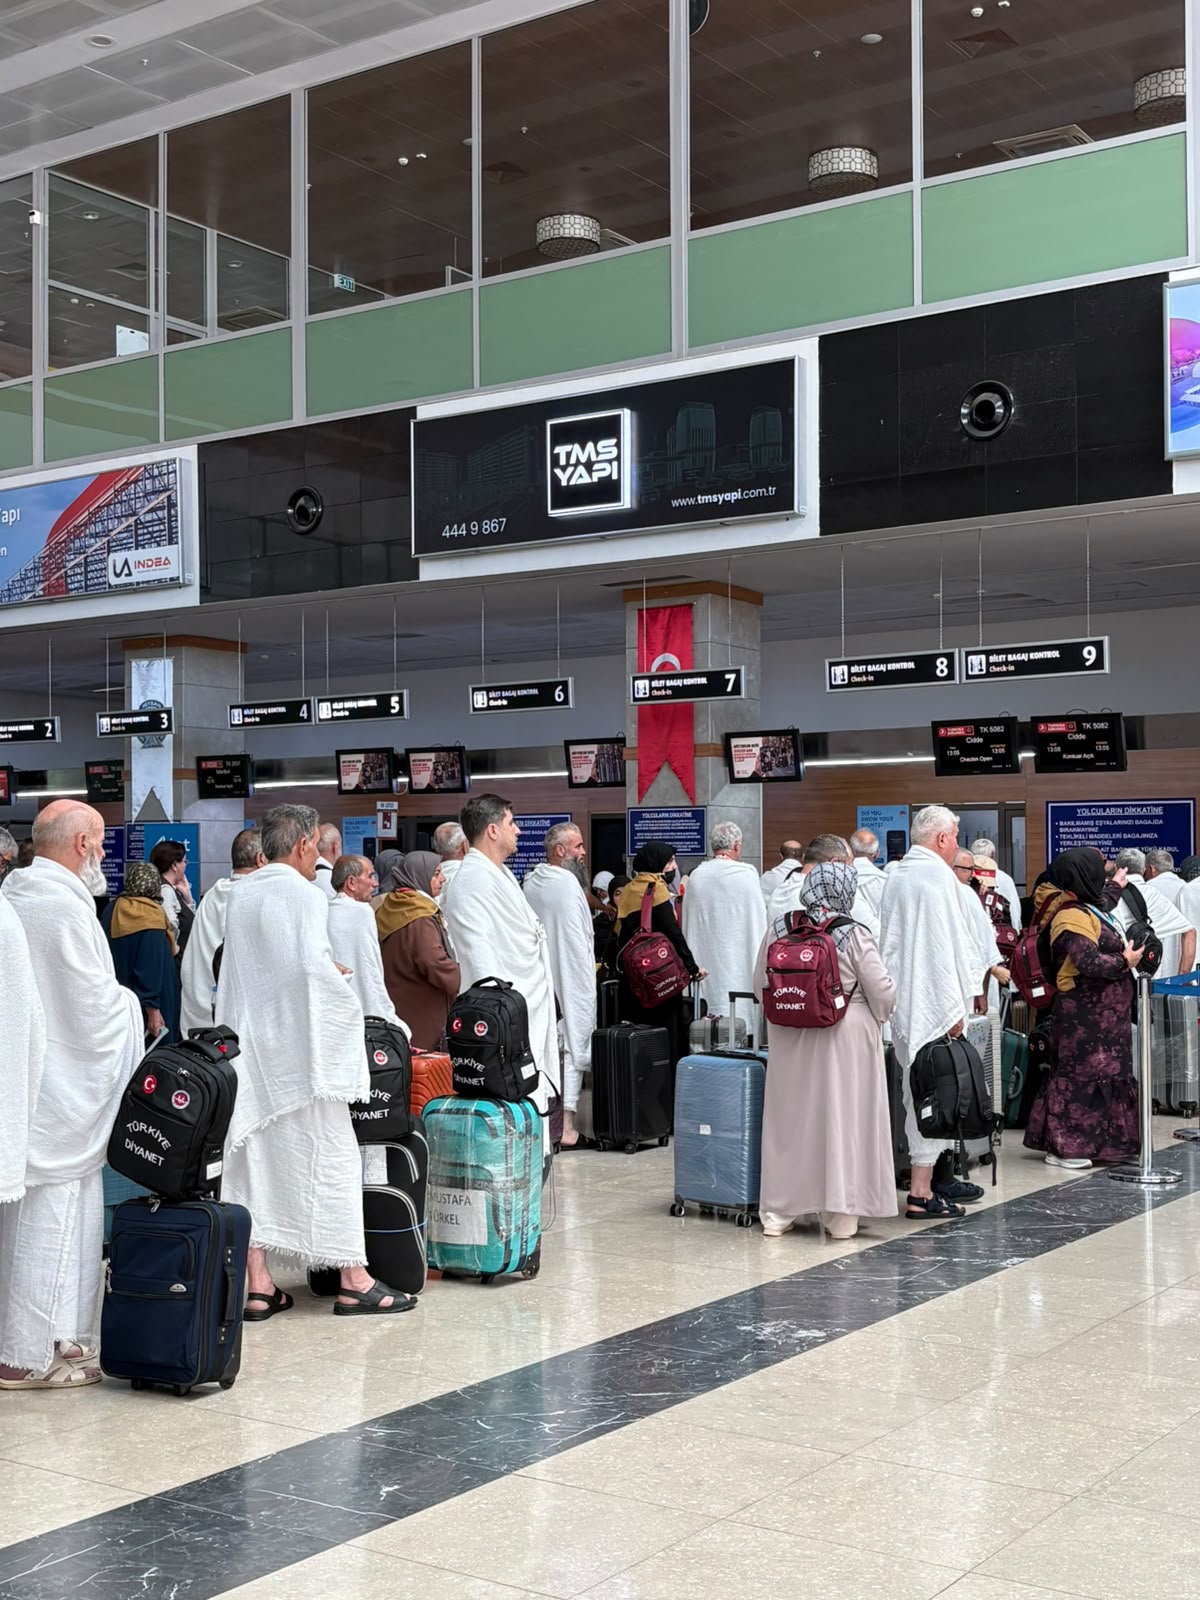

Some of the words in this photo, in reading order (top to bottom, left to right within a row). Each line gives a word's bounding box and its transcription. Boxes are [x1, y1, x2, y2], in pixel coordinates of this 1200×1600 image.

[553, 438, 618, 466] TMS
[553, 461, 618, 486] YAPI
[671, 485, 777, 508] www.tmsyapi.com.tr
[0, 508, 20, 526] apı
[441, 523, 467, 539] 444
[470, 521, 479, 536] 9
[481, 518, 507, 535] 867
[134, 556, 171, 570] INDEA
[1007, 652, 1028, 662] BAGAJ
[1029, 650, 1060, 660] KONTROL
[1082, 646, 1097, 667] 9
[867, 663, 886, 672] BAGAJ
[888, 661, 915, 671] KONTROL
[936, 657, 948, 677] 8
[989, 664, 1015, 673] Check-in
[724, 673, 736, 692] 7
[554, 685, 565, 703] 6
[299, 703, 308, 720] 4
[390, 696, 400, 714] 5
[45, 722, 53, 737] 2
[160, 713, 169, 729] 3
[1092, 722, 1109, 730] 5082
[1076, 807, 1122, 817] YOLCULARIN
[1124, 805, 1164, 815] DİKKATİNE
[776, 1002, 806, 1010] DİYANET
[369, 1088, 391, 1102] KİYE
[126, 1120, 172, 1151] TÜRKİYE
[124, 1138, 164, 1167] DİYANET
